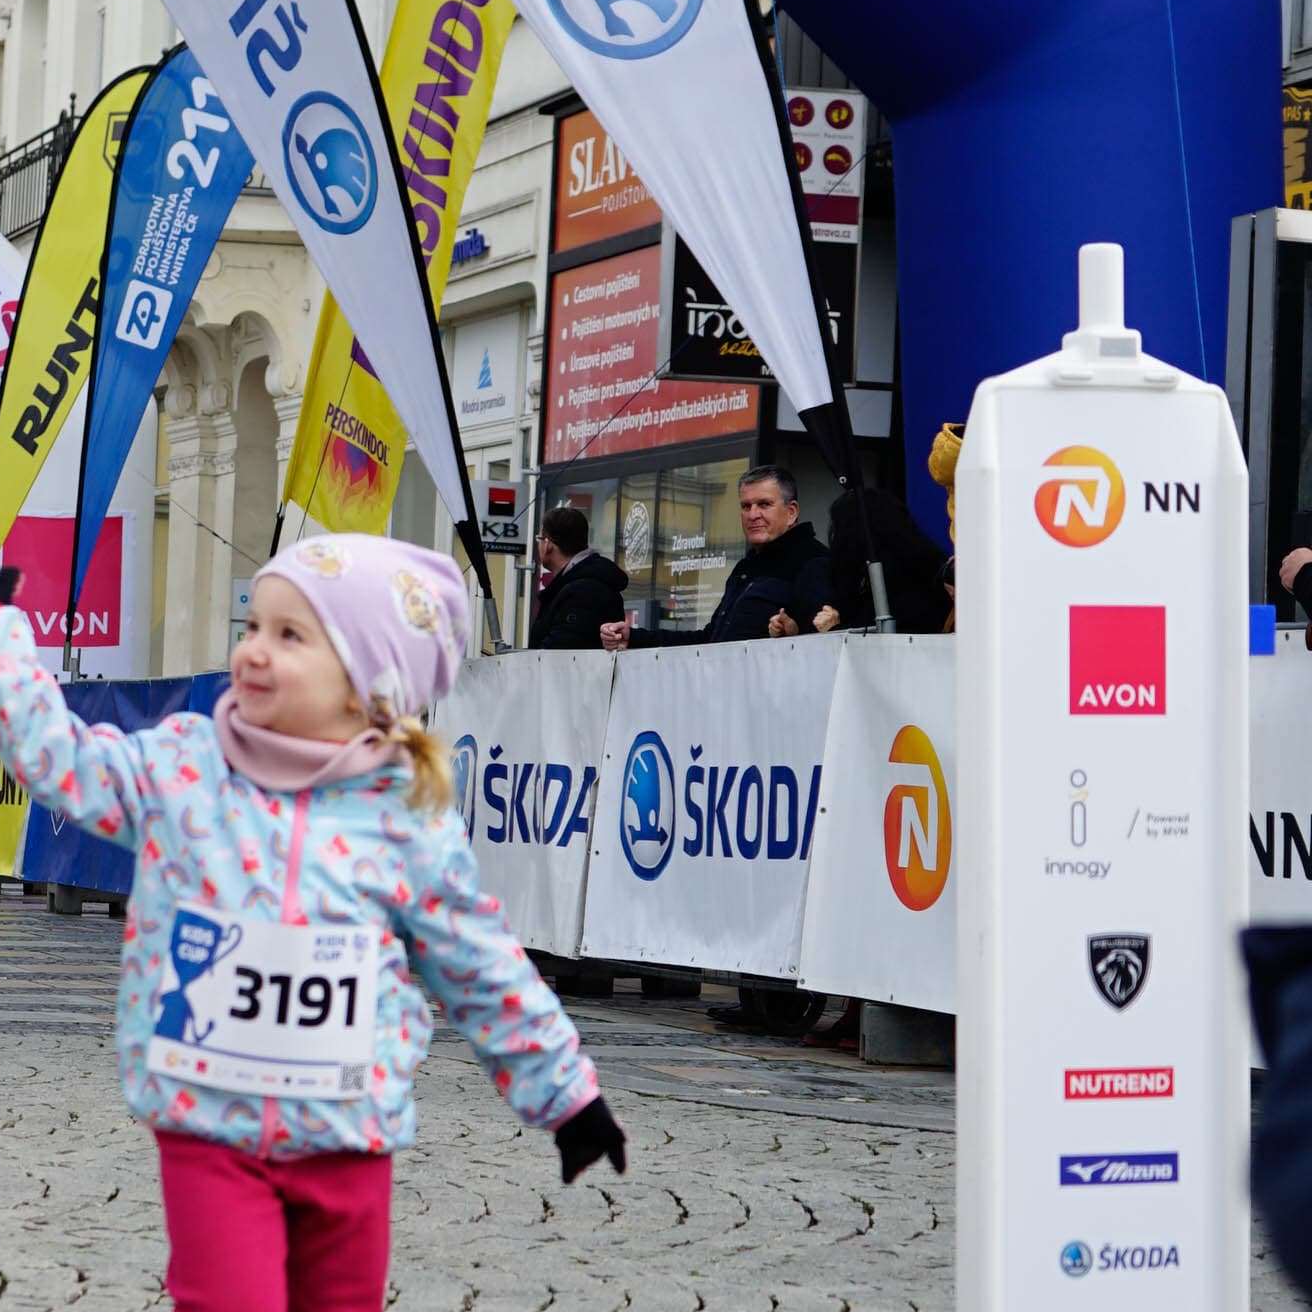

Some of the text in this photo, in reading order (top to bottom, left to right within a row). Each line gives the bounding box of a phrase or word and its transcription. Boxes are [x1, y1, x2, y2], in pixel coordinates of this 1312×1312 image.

[568, 134, 632, 198] SLAV
[132, 194, 165, 276] ZDRAVOTNÍ
[157, 186, 195, 284] MINISTERSTVA
[167, 213, 199, 286] VNITRA ČR
[11, 276, 100, 457] RUNT
[324, 402, 389, 467] PERSKINDOL
[1143, 481, 1201, 515] NN
[482, 521, 520, 538] KB
[672, 532, 706, 551] Zdravotní
[34, 610, 109, 636] VON
[1078, 683, 1157, 708] AVON
[1044, 856, 1112, 879] innogy
[229, 966, 358, 1028] 3191
[1069, 1073, 1171, 1096] NUTREND
[1098, 1244, 1180, 1271] ŠKODA
